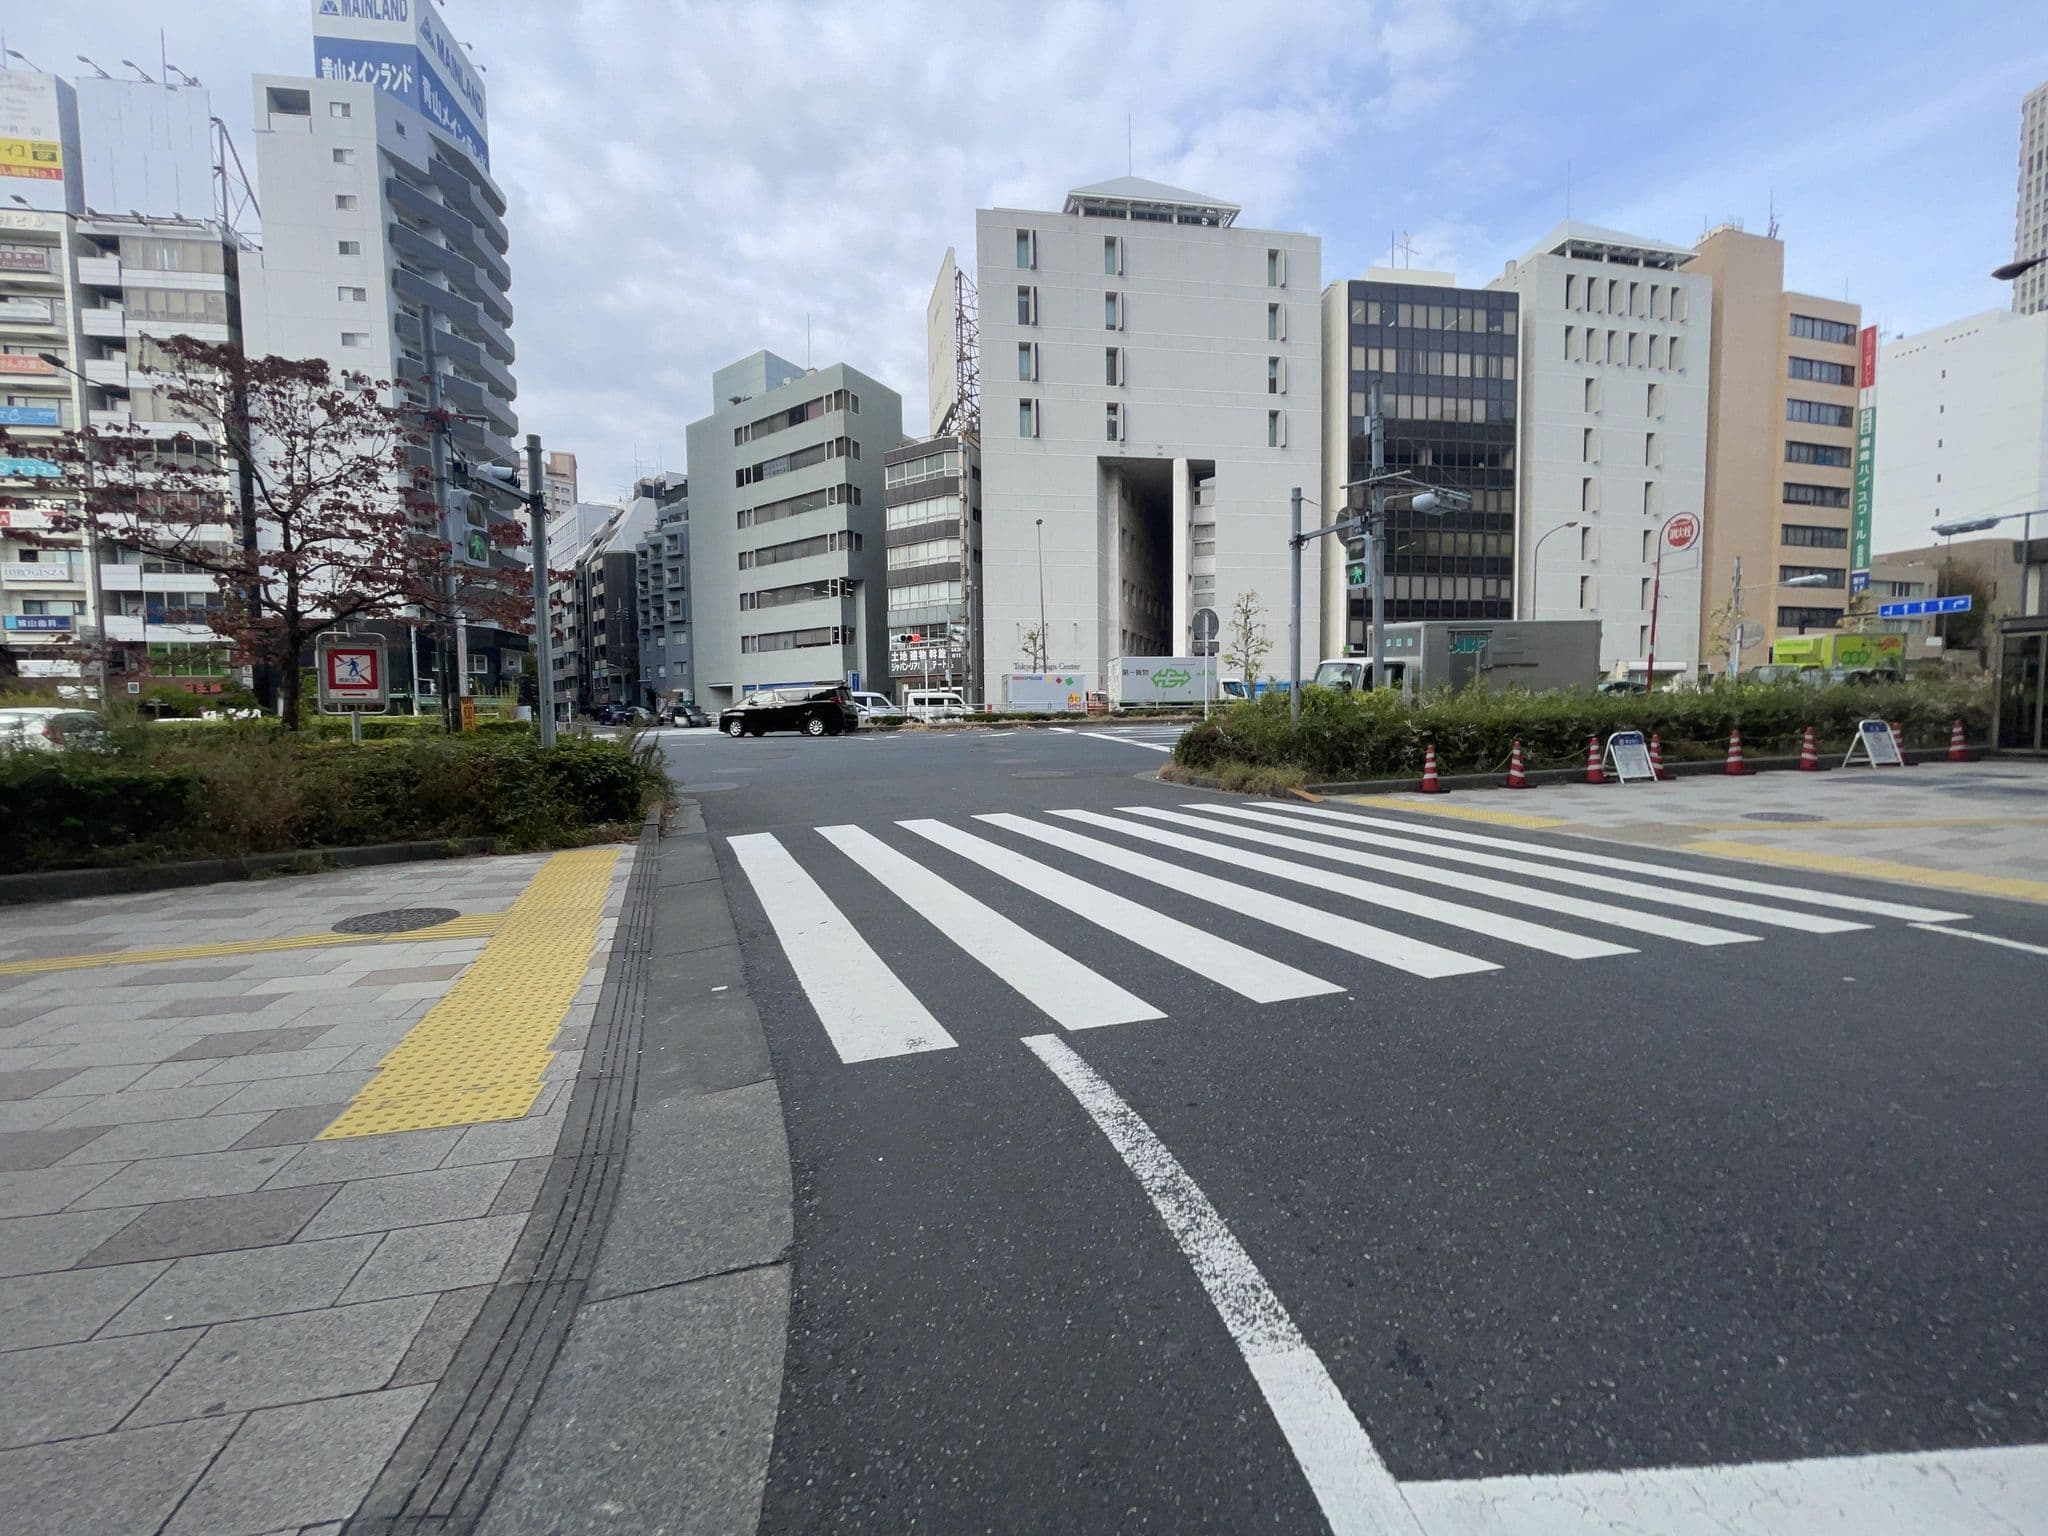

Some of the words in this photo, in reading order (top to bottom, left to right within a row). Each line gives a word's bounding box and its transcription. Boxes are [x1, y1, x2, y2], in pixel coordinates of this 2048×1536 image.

[341, 0, 408, 22] MAINLAND
[321, 57, 412, 93] 青山メインランド
[436, 33, 484, 120] MAINLAND
[4, 568, 65, 577] HIROGINZA
[1013, 662, 1035, 671] Tokyo
[1036, 662, 1057, 671] Design
[1059, 662, 1080, 670] Center
